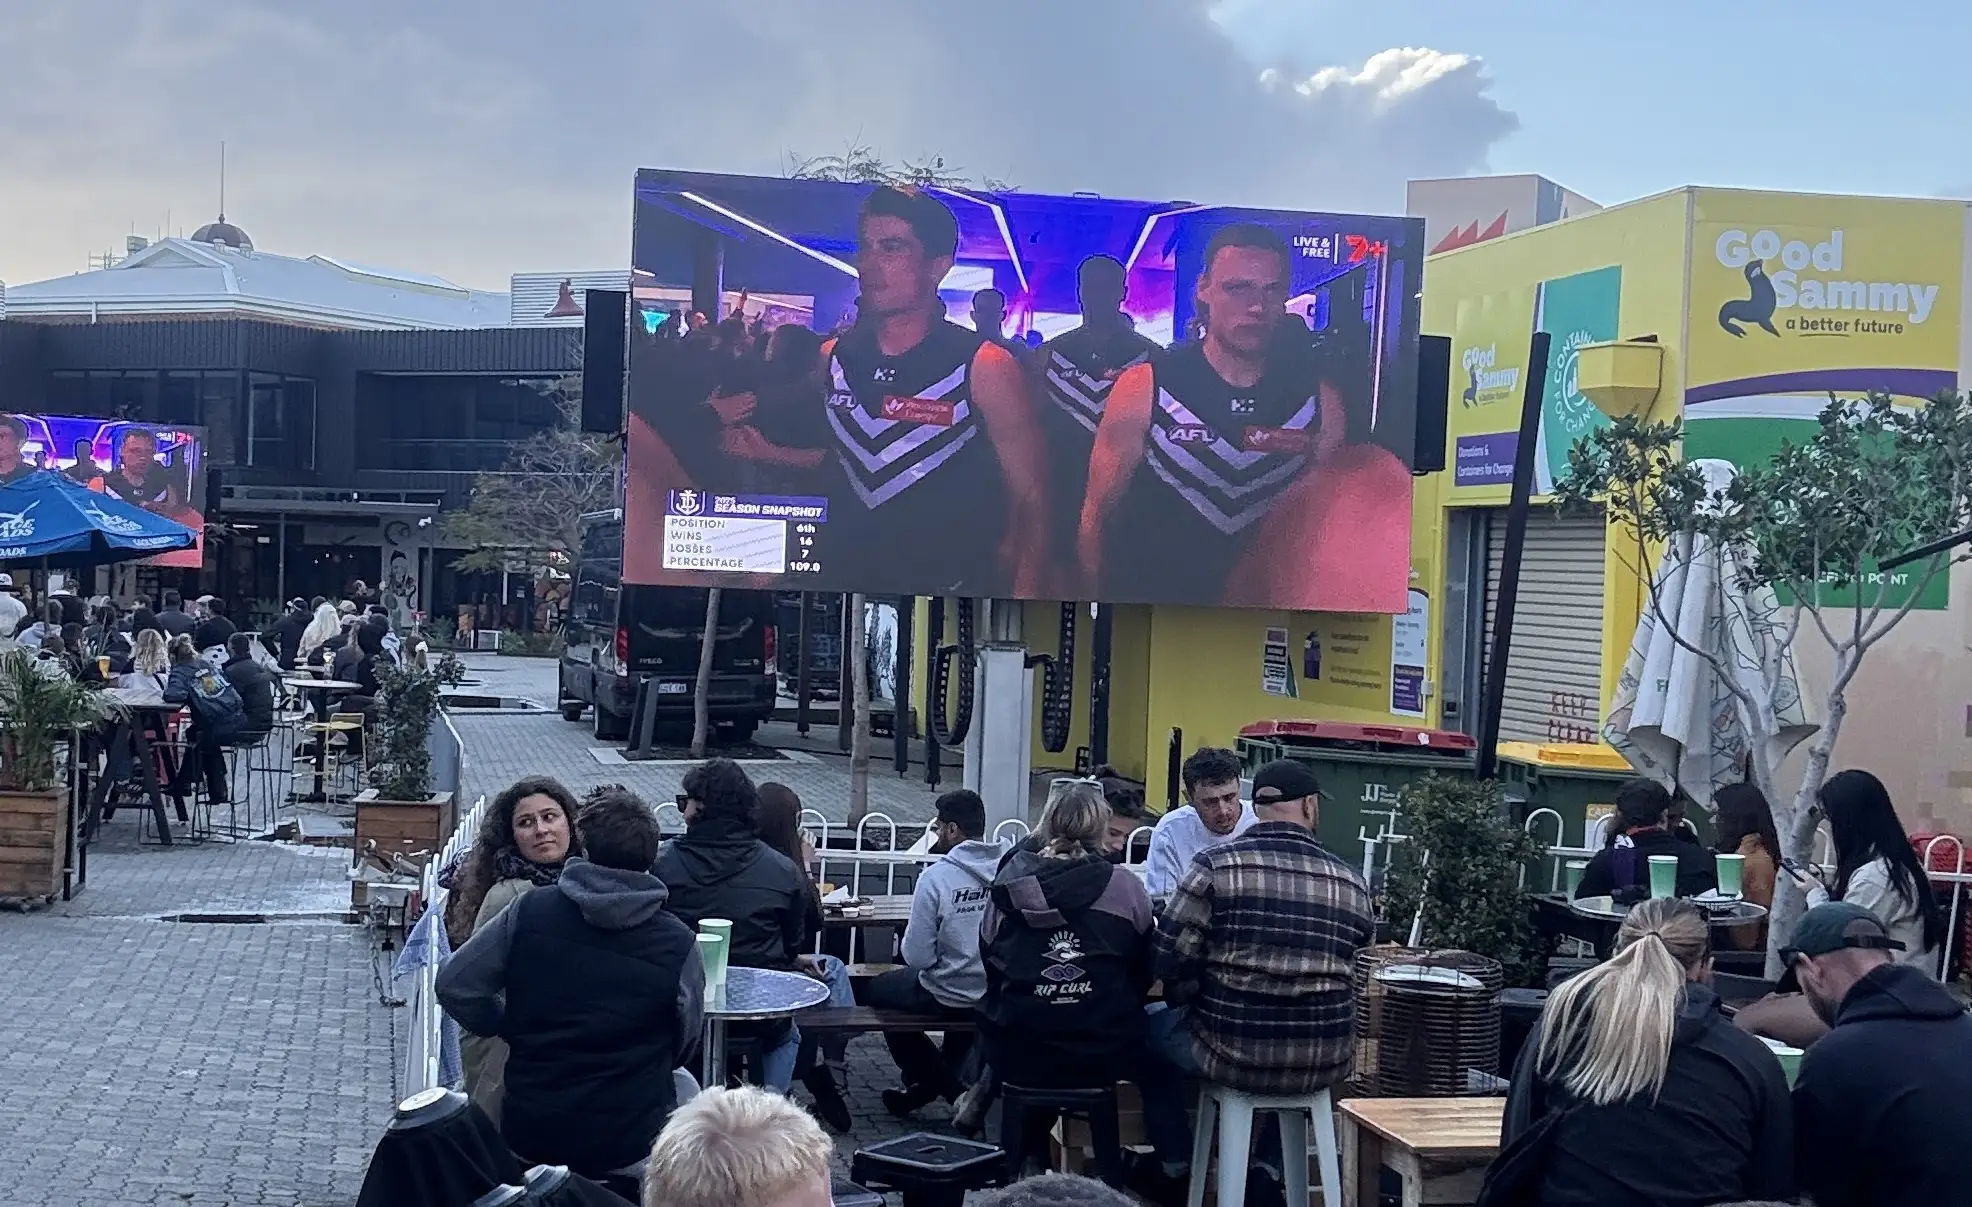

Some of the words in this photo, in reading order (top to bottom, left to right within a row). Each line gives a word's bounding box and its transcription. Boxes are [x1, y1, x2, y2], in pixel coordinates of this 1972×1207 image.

[1293, 236, 1319, 248] LIVE
[1321, 237, 1330, 248] &
[1302, 247, 1331, 259] FREE
[1716, 229, 1843, 272] Good
[1772, 270, 1940, 323] Sammy
[1785, 318, 1796, 330] a
[1800, 316, 1850, 332] better
[1854, 318, 1904, 334] future
[1463, 342, 1496, 371] Good
[1555, 330, 1596, 384] CONTAIN
[1475, 366, 1520, 392] Sammy
[1169, 428, 1214, 443] AFL
[714, 504, 761, 515] SEASON
[761, 505, 824, 517] SNAPSHOT
[671, 518, 726, 529] POSITION
[671, 532, 702, 541] WINS
[799, 536, 813, 546] 16
[670, 545, 712, 554] LOSSES
[801, 549, 810, 559] 7
[670, 557, 744, 568] PERCENTAGE
[1868, 573, 1908, 585] PONT
[1034, 984, 1057, 996] RIP
[1060, 981, 1092, 994] CURL
